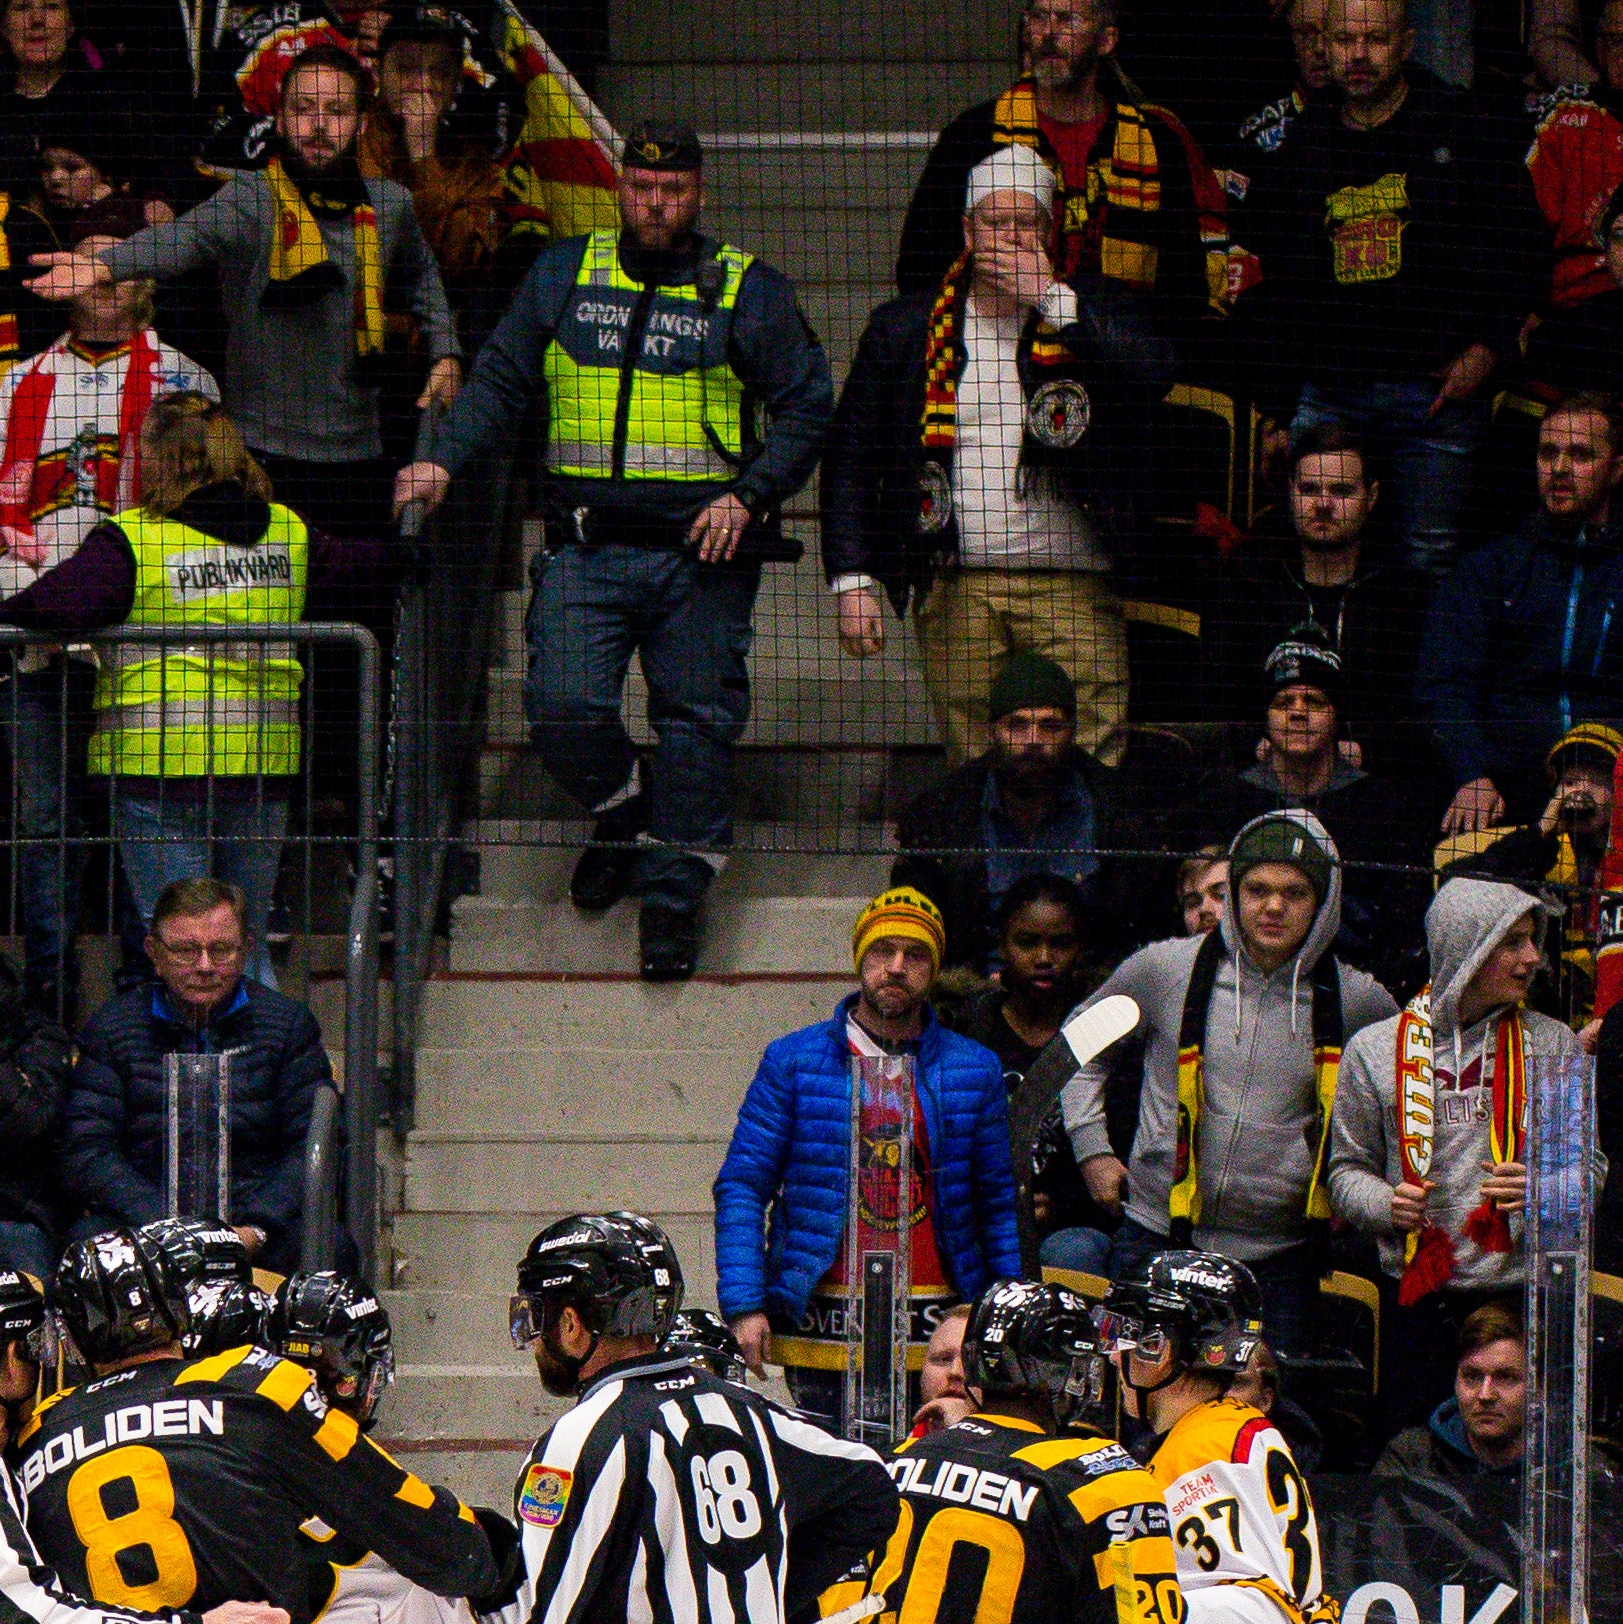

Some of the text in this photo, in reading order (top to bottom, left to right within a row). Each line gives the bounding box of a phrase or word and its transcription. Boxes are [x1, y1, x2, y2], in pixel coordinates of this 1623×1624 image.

[538, 1230, 591, 1254] swedol
[542, 1274, 573, 1288] CCM
[654, 1268, 670, 1287] 68
[127, 1290, 143, 1307] 8
[4, 1318, 33, 1330] CCM
[983, 1327, 1004, 1343] 20
[86, 1369, 138, 1394] CCM
[654, 1376, 696, 1391] CCM
[25, 1400, 223, 1496] BOLIDEN
[886, 1457, 1040, 1521] OLIDEN
[1179, 1473, 1215, 1496] TEAM
[690, 1450, 762, 1545] 68
[66, 1444, 197, 1613] 8
[1175, 1497, 1244, 1572] 37
